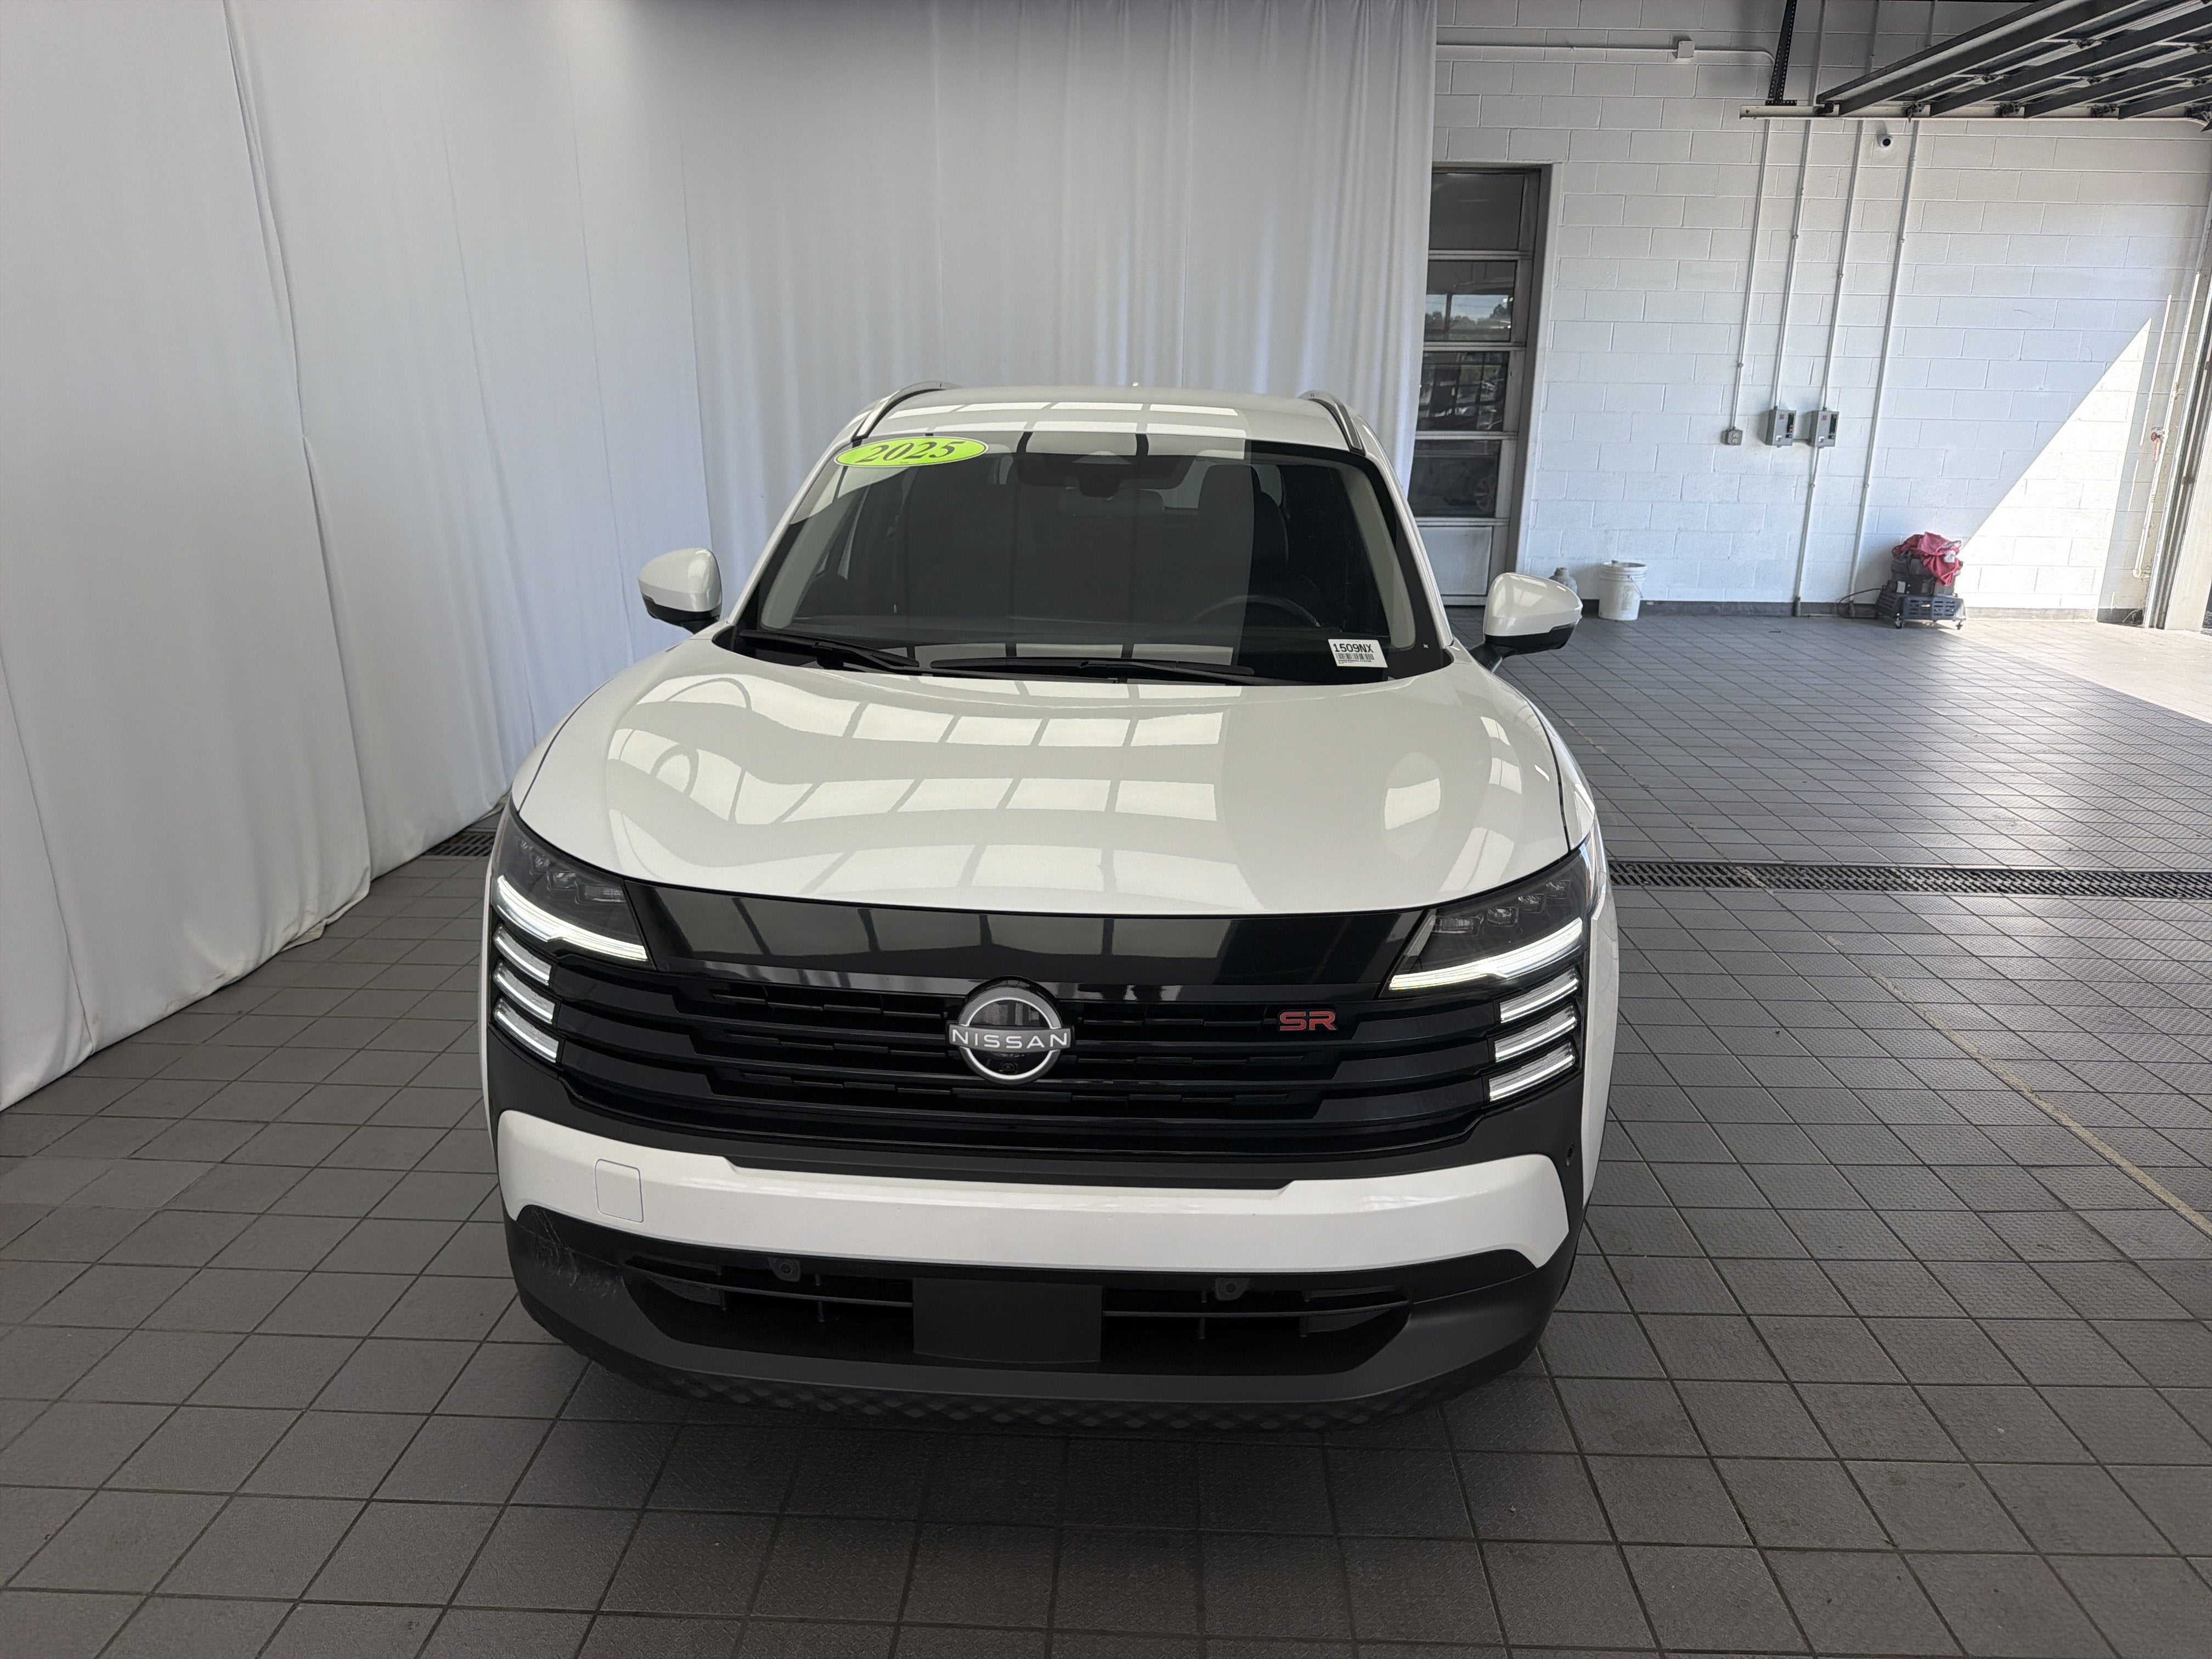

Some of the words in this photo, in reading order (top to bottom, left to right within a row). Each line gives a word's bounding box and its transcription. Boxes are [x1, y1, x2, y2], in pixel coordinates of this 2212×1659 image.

[854, 441, 966, 463] 2025
[1333, 643, 1374, 653] 1509NX
[1279, 1011, 1337, 1031] SR
[952, 1029, 1067, 1049] NISSAN
